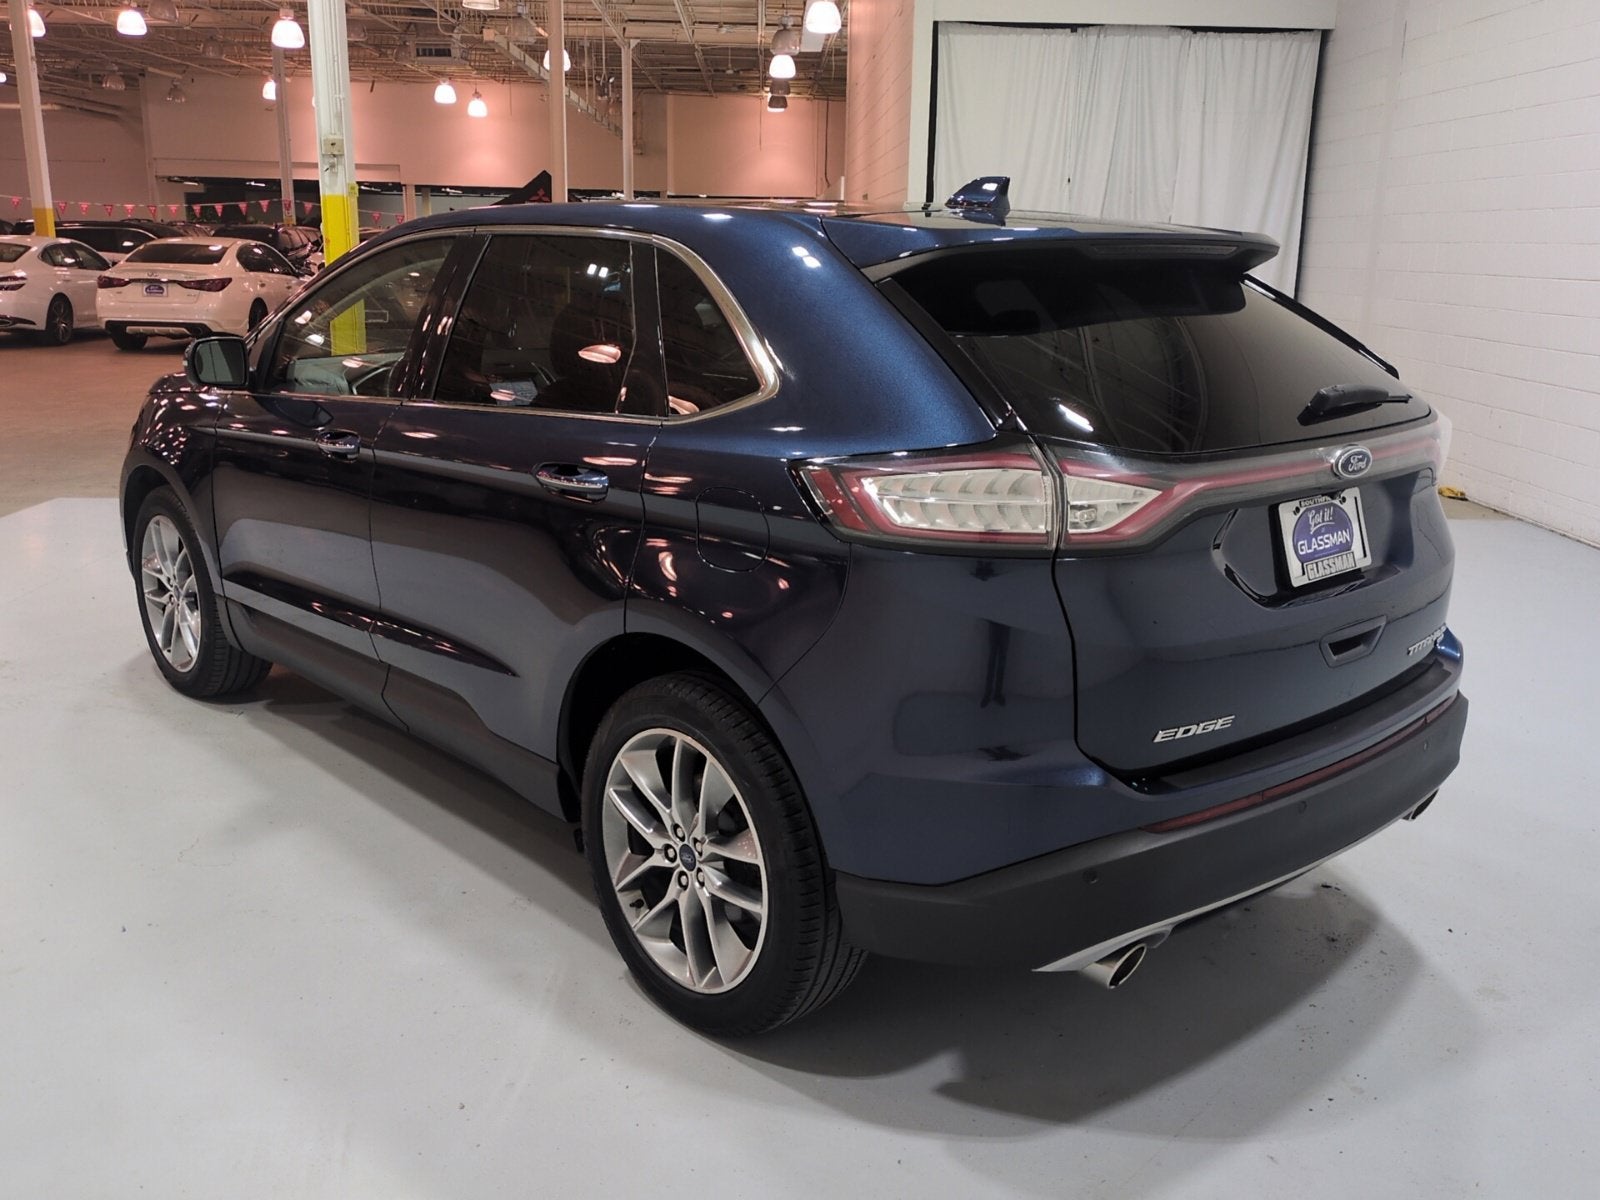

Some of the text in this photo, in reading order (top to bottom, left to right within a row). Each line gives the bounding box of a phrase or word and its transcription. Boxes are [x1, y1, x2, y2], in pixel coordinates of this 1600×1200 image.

[1348, 454, 1367, 472] Ford
[1297, 528, 1351, 556] GLASSMAN
[1306, 552, 1355, 580] GLASSMAN
[1153, 715, 1236, 743] EDGE
